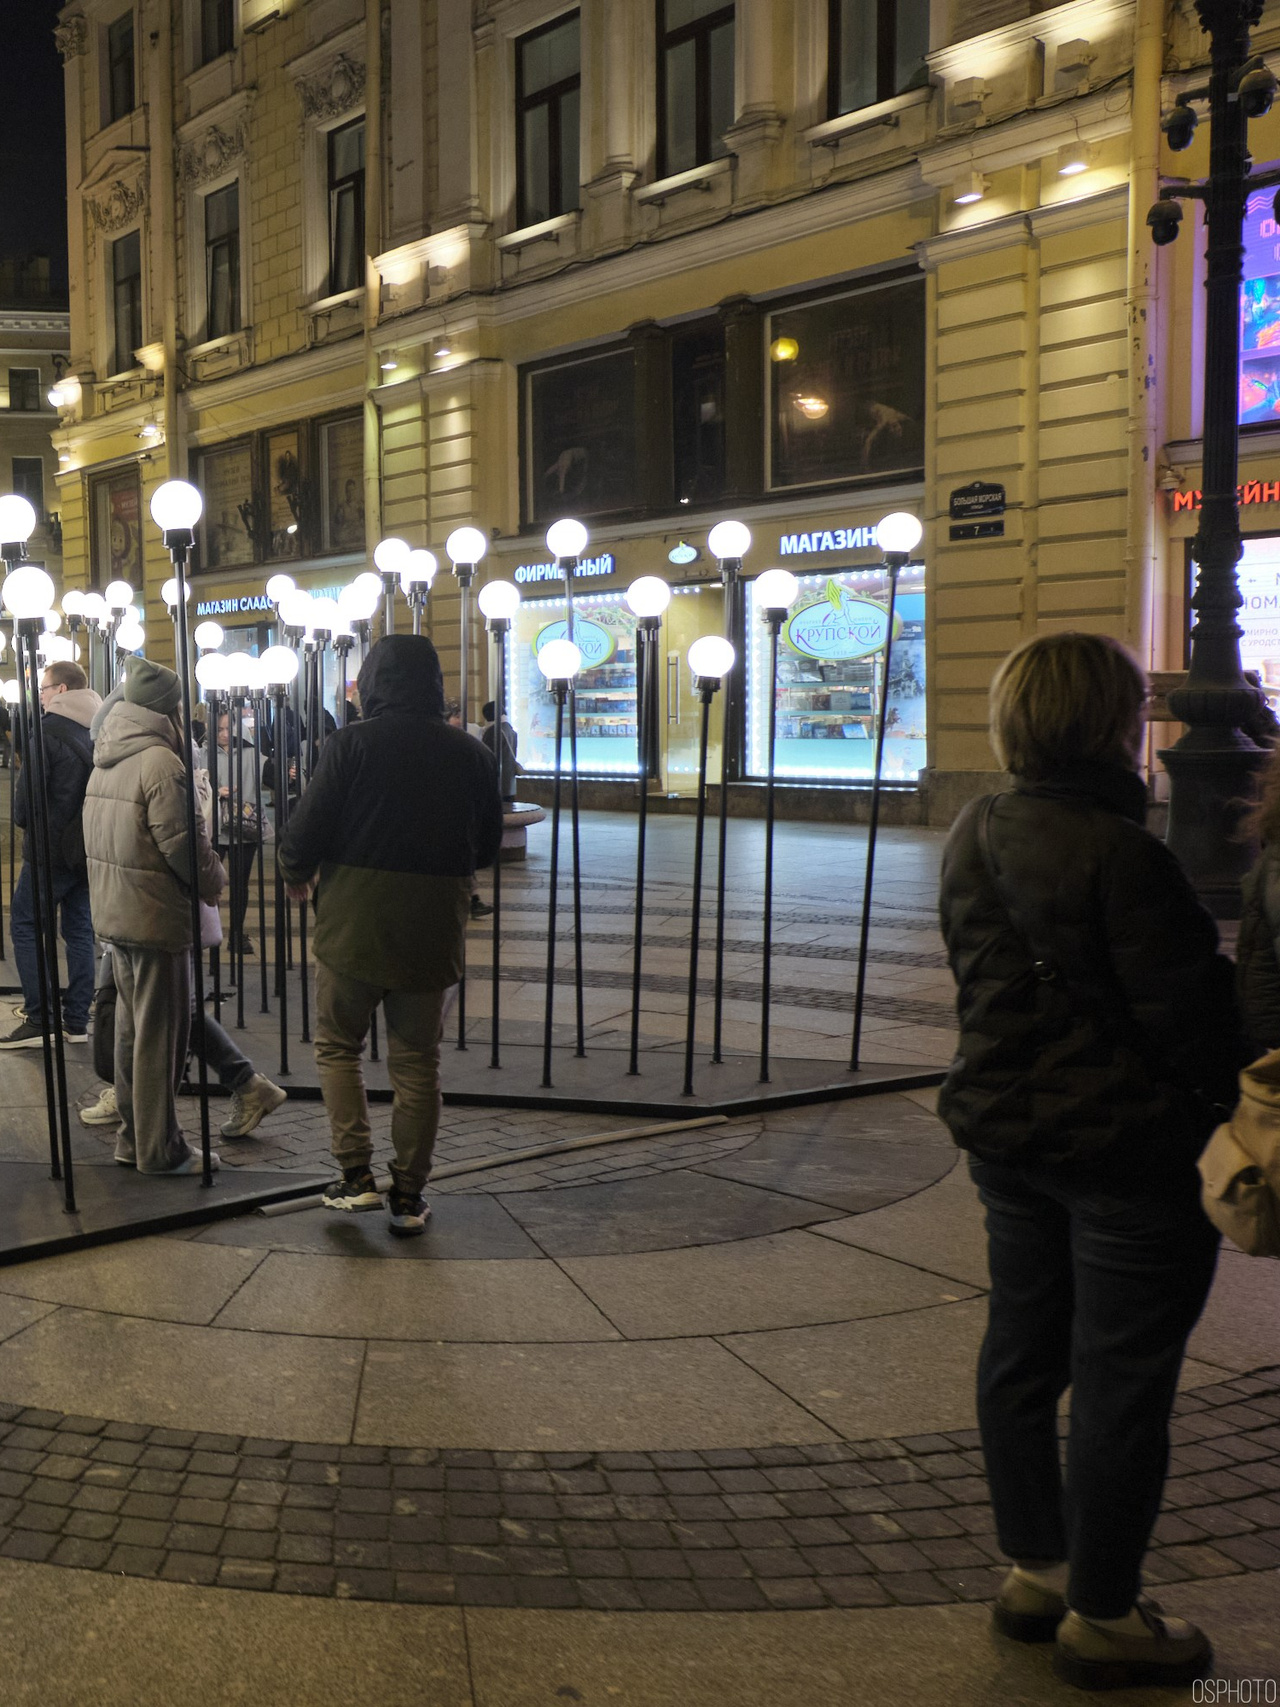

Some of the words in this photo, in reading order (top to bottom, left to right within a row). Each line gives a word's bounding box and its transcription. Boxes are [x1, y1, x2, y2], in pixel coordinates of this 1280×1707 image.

[953, 495, 977, 506] БОЛЬШАЯ
[978, 492, 1002, 503] МОРСКАЯ
[1174, 479, 1280, 512] МЙН
[780, 525, 878, 555] МАГАЗИН
[973, 525, 980, 536] 7
[514, 553, 613, 583] ФИРМЕНЫЙ
[196, 598, 239, 616] МАГАЗИН
[795, 620, 882, 648] КРУПСКОЙ
